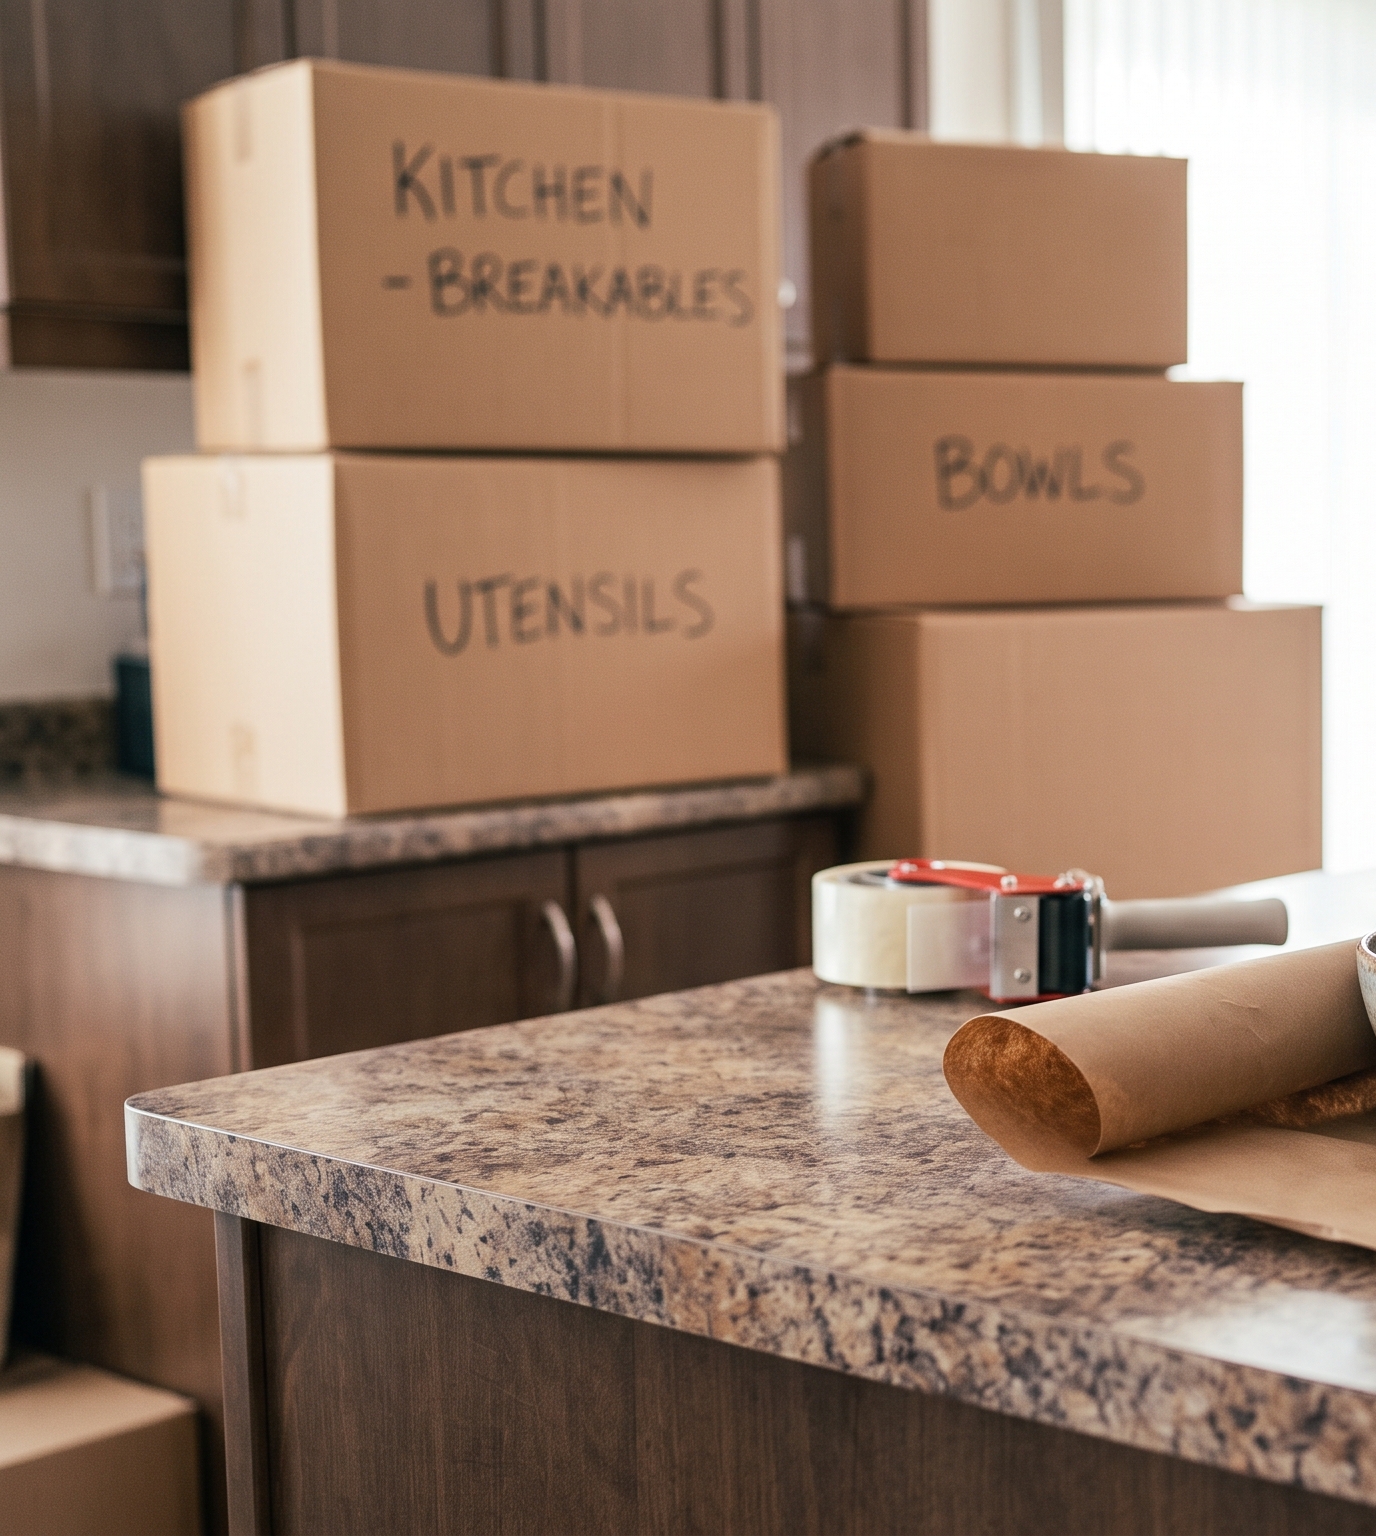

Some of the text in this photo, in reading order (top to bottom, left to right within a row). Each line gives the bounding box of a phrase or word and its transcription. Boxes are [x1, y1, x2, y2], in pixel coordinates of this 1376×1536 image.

[392, 141, 654, 229] KITCHEN
[934, 434, 1144, 512] BOWLS
[423, 567, 716, 657] UTENSILS
